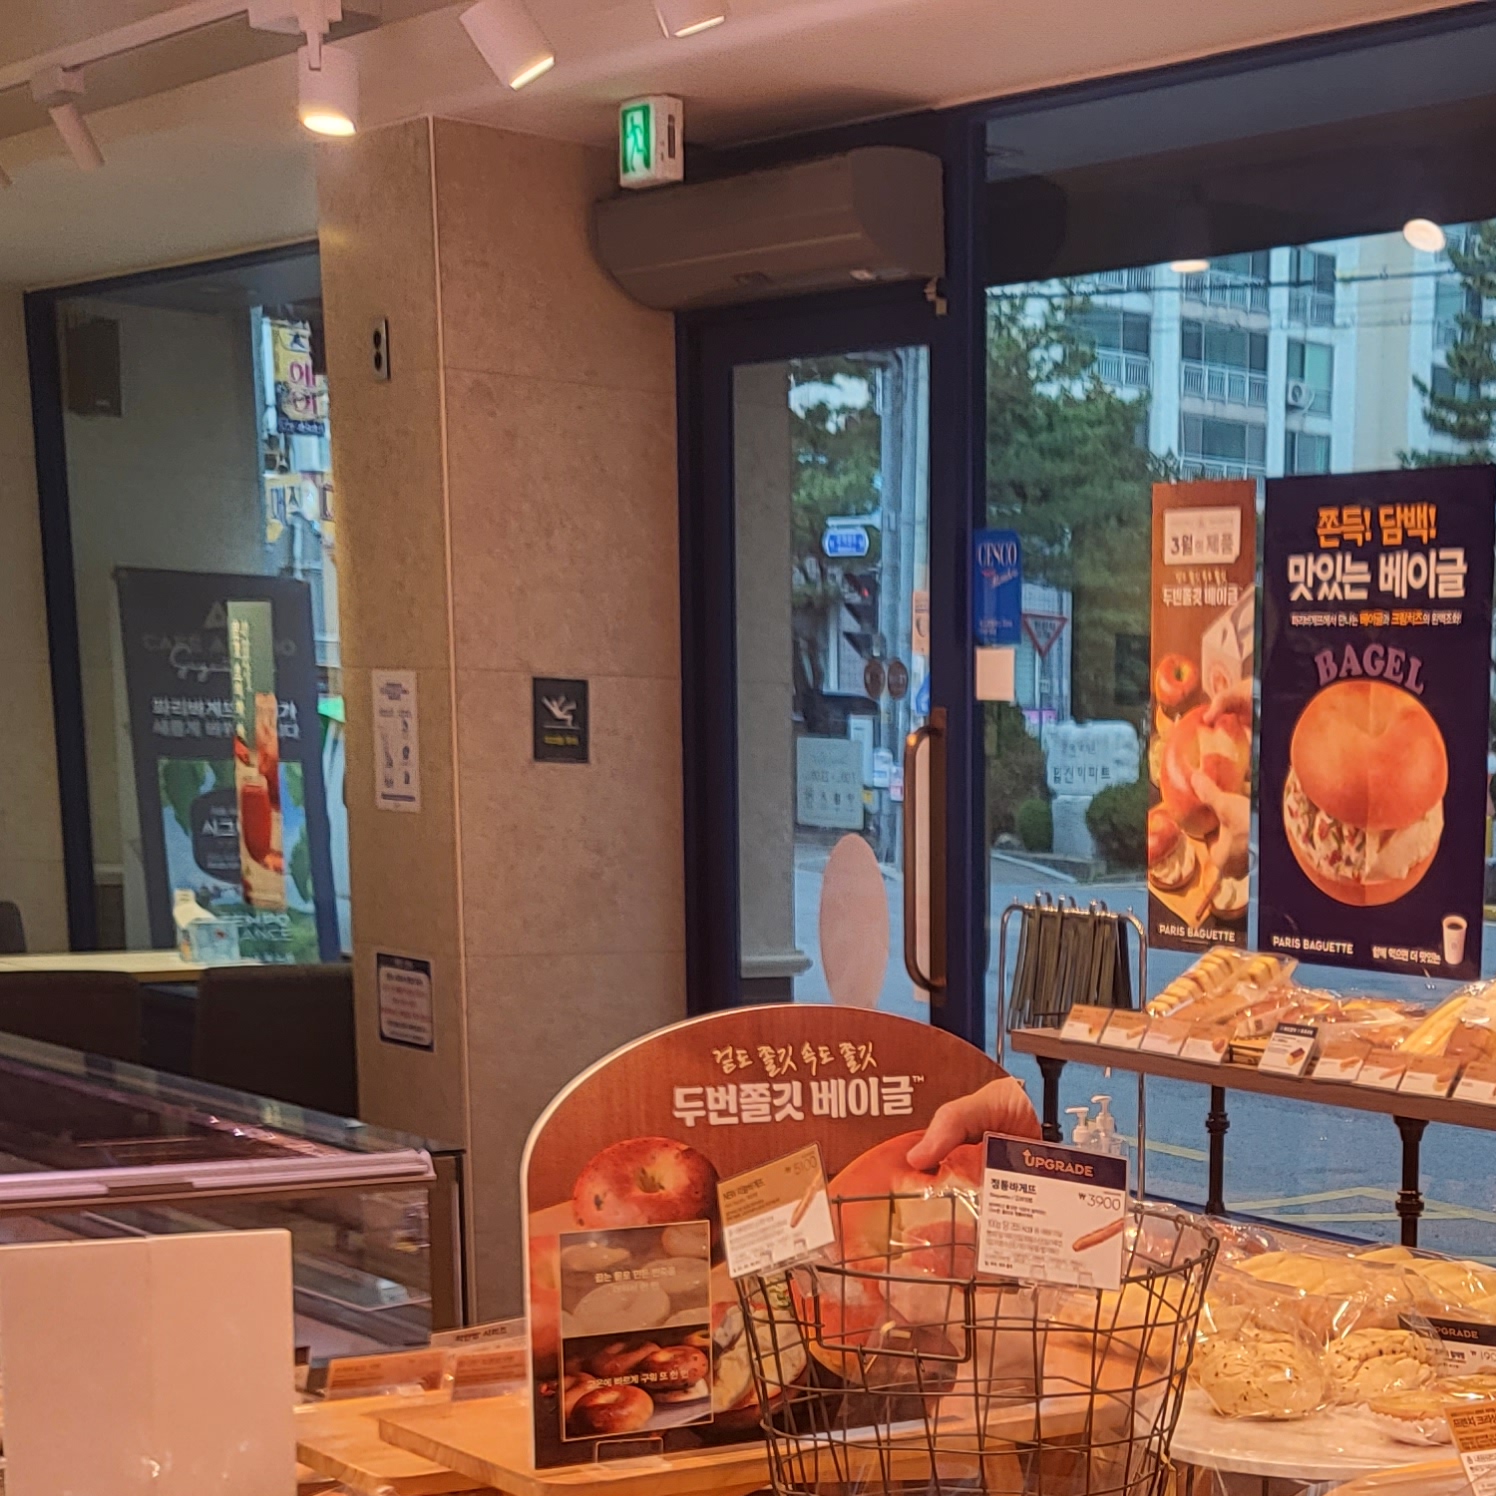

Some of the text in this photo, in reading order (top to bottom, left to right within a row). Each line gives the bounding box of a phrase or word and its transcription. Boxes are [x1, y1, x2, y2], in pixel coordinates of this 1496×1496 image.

[1317, 502, 1436, 548] 쫀득! 담백!
[1288, 547, 1468, 600] 맛있는 베이글
[1314, 642, 1425, 695] BAGEL
[1159, 924, 1235, 942] PARIS BAGUETTE
[1273, 936, 1354, 955] PARIS BAGUETTE
[672, 1080, 805, 1127] 두번쫄깃
[810, 1075, 914, 1118] 베이글
[1021, 1146, 1094, 1178] UPGRADE
